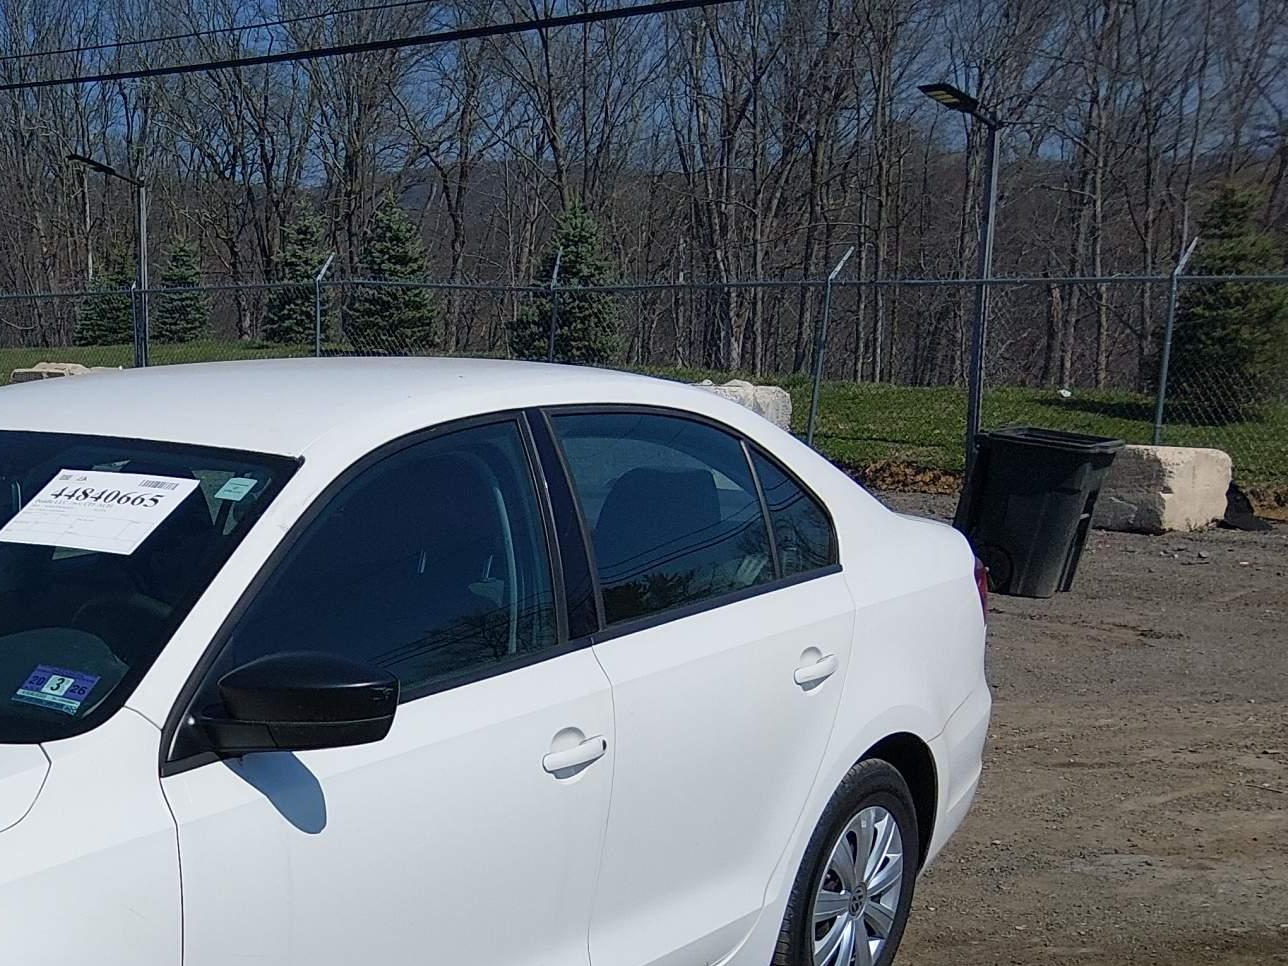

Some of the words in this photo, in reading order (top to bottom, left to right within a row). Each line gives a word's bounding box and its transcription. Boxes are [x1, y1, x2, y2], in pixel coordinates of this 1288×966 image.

[51, 486, 164, 508] 44840665
[28, 675, 46, 687] 20
[50, 677, 65, 692] 3
[69, 684, 88, 696] 26
